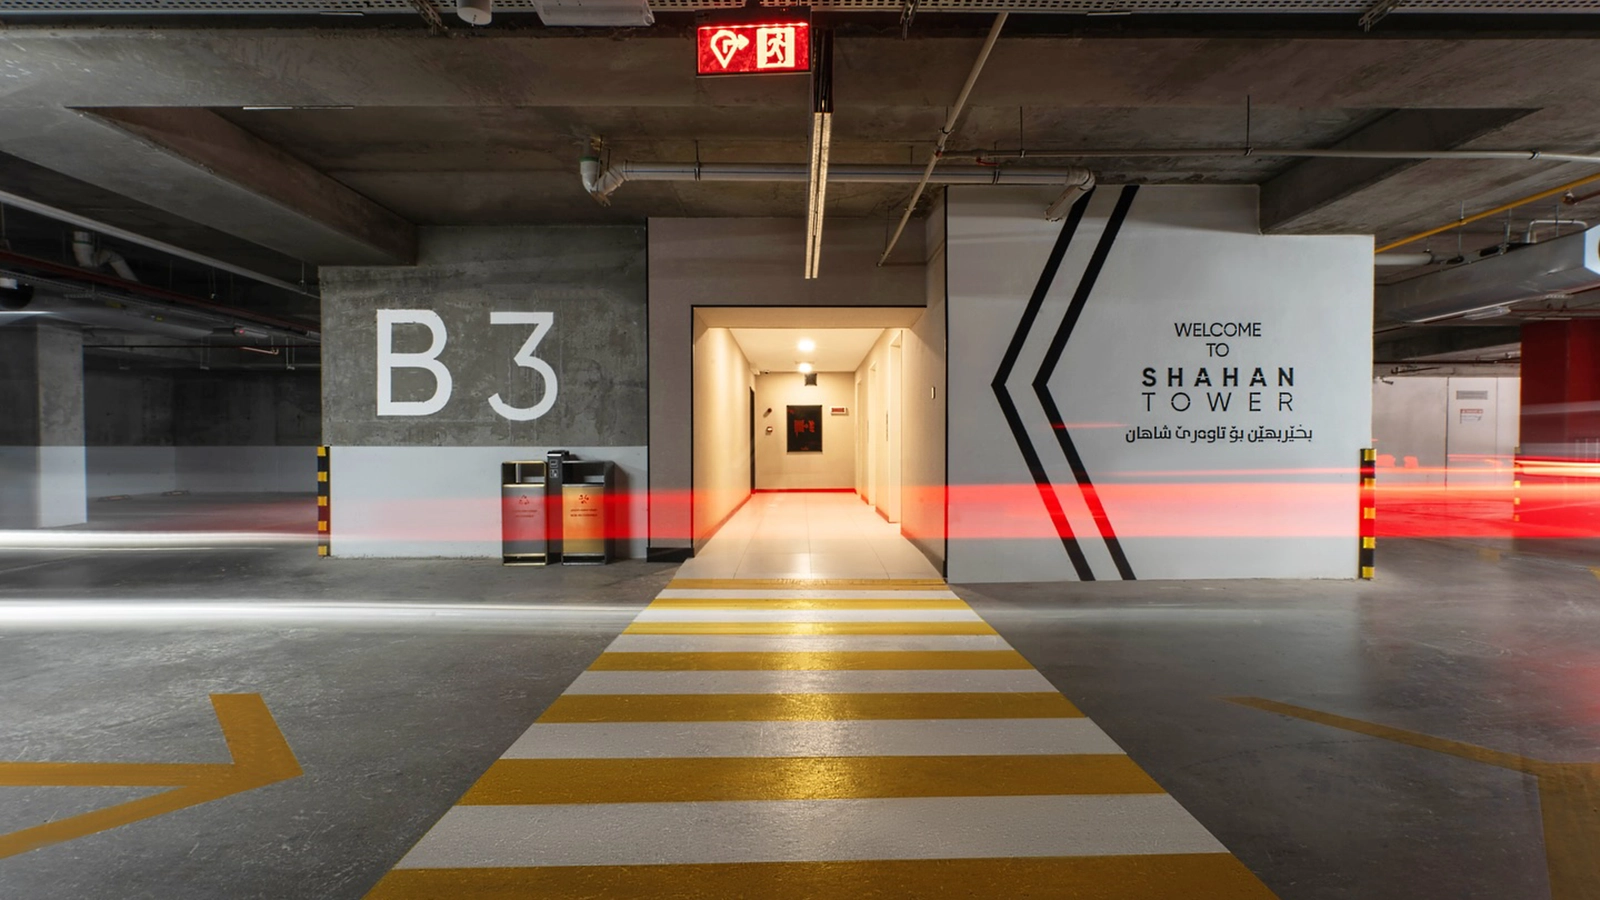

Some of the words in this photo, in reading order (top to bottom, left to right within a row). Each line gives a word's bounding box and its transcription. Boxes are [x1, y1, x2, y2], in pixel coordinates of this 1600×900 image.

[1174, 323, 1261, 337] WELCOME
[1206, 343, 1229, 357] TO
[1142, 367, 1293, 387] SHAHAN
[1142, 392, 1292, 412] TOWER
